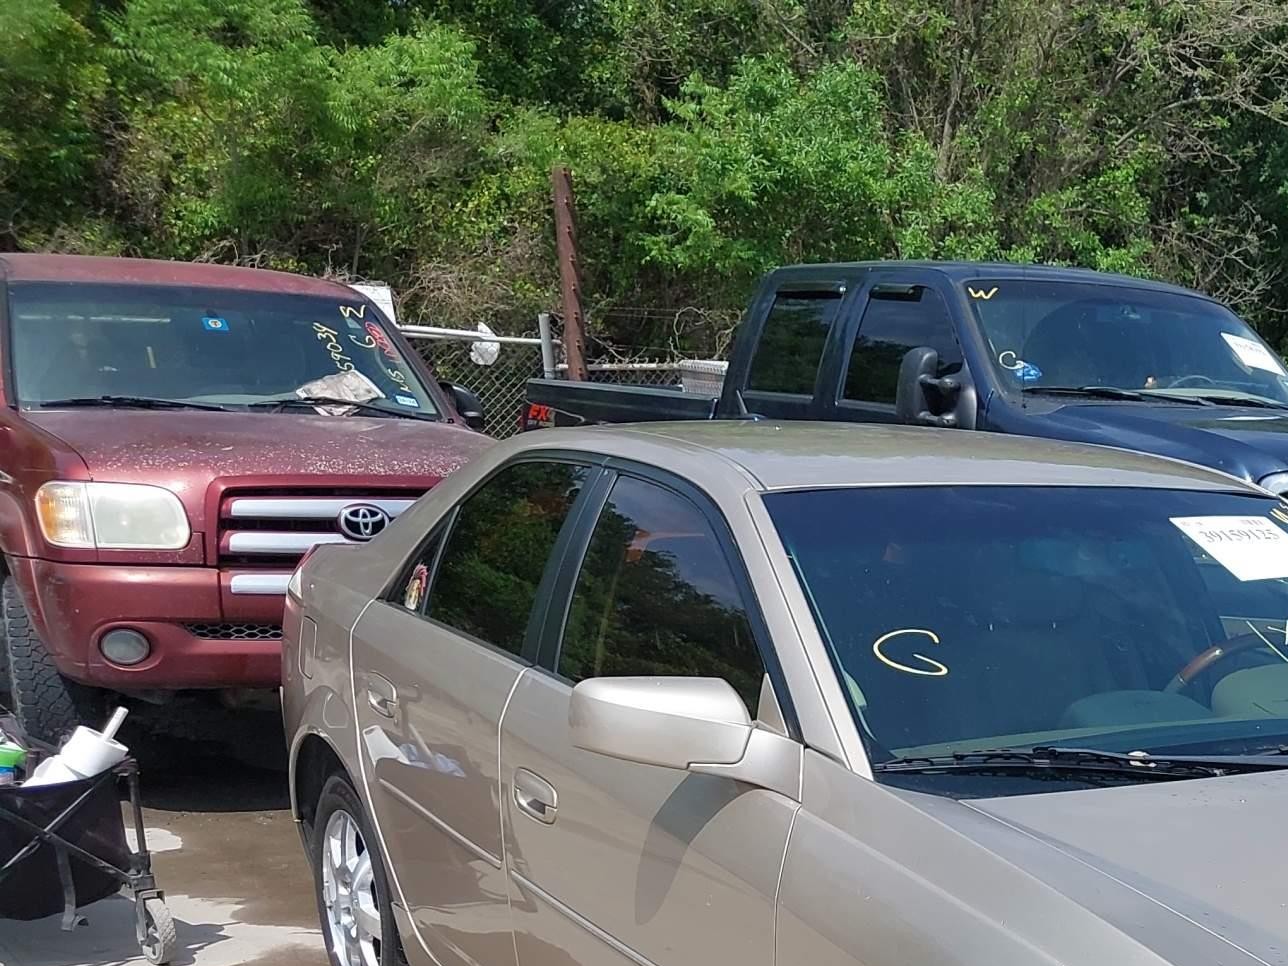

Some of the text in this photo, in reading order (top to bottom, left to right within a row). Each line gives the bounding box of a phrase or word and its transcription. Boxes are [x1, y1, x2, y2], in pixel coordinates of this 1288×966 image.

[313, 321, 355, 374] 59034
[1198, 528, 1281, 543] 39159125
[872, 628, 949, 676] G
